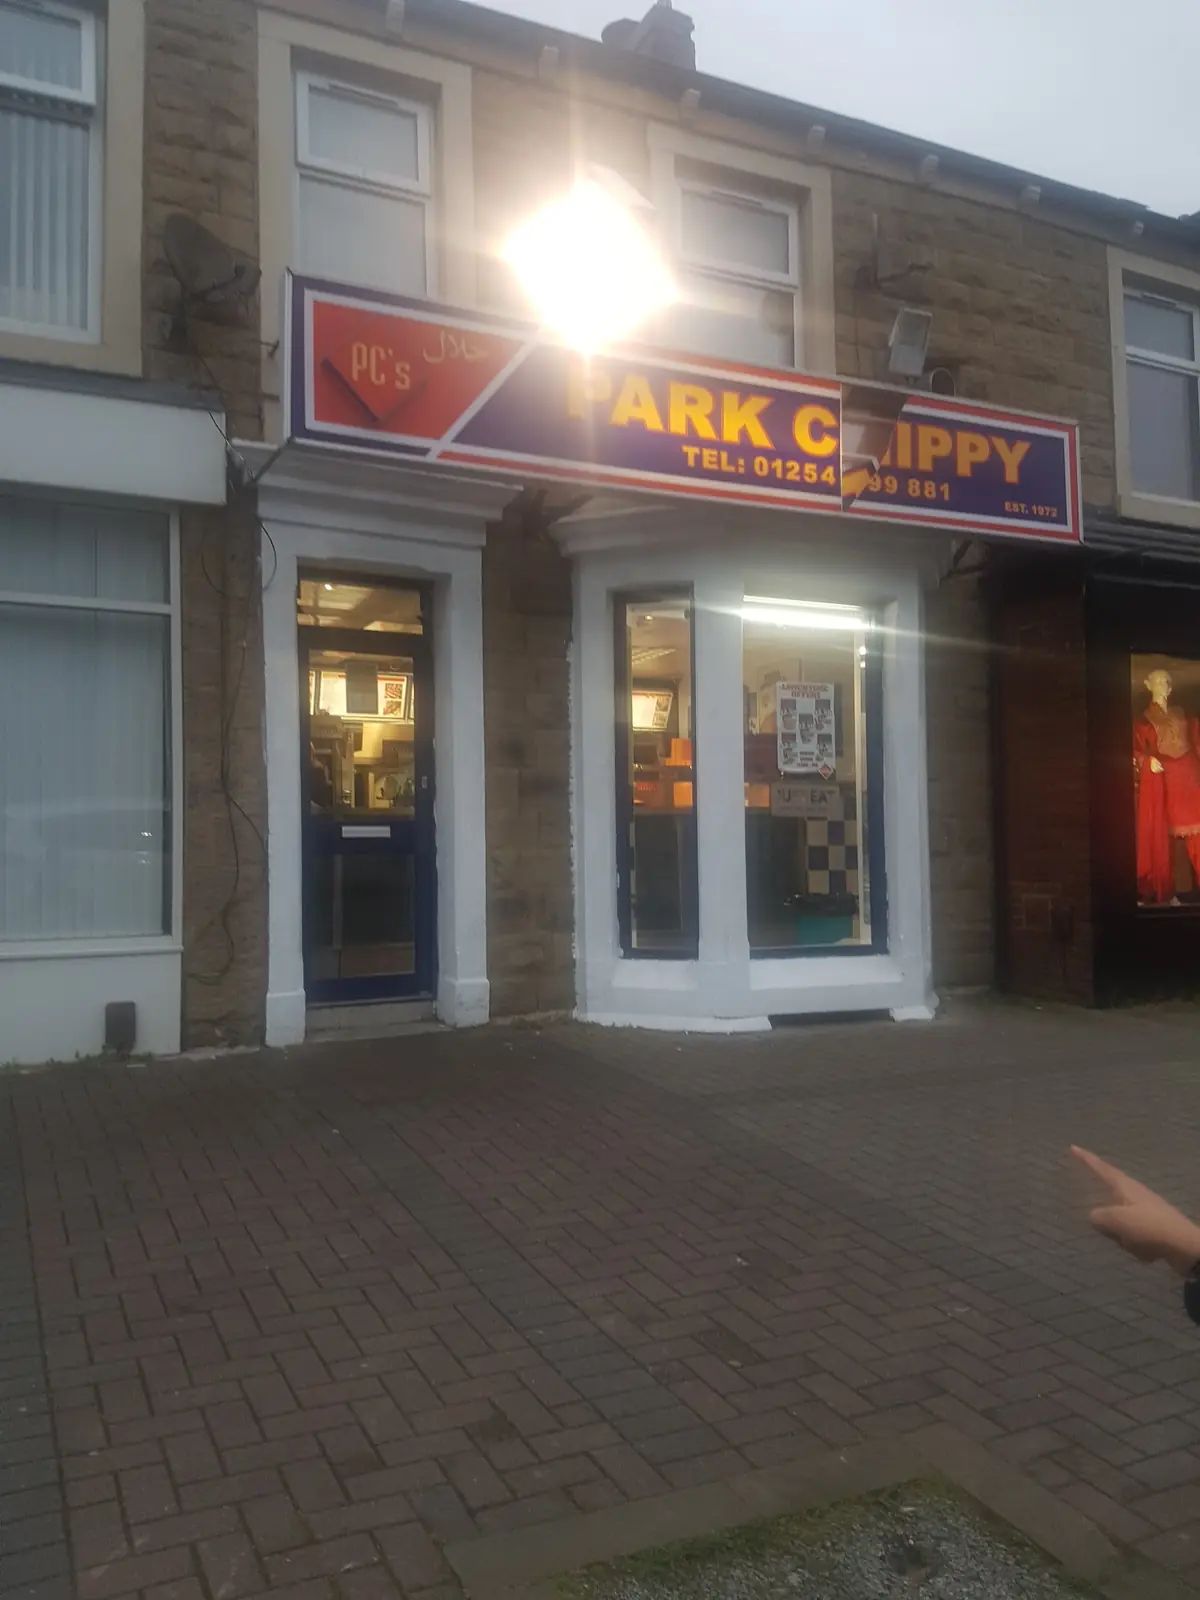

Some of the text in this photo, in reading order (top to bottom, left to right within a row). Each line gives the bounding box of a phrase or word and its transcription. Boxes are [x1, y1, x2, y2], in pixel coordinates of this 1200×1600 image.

[565, 362, 1032, 485] PARK CIPPY
[682, 445, 745, 475] TEL:
[753, 455, 837, 486] 01254
[907, 477, 950, 501] 881
[1004, 500, 1029, 515] EST.
